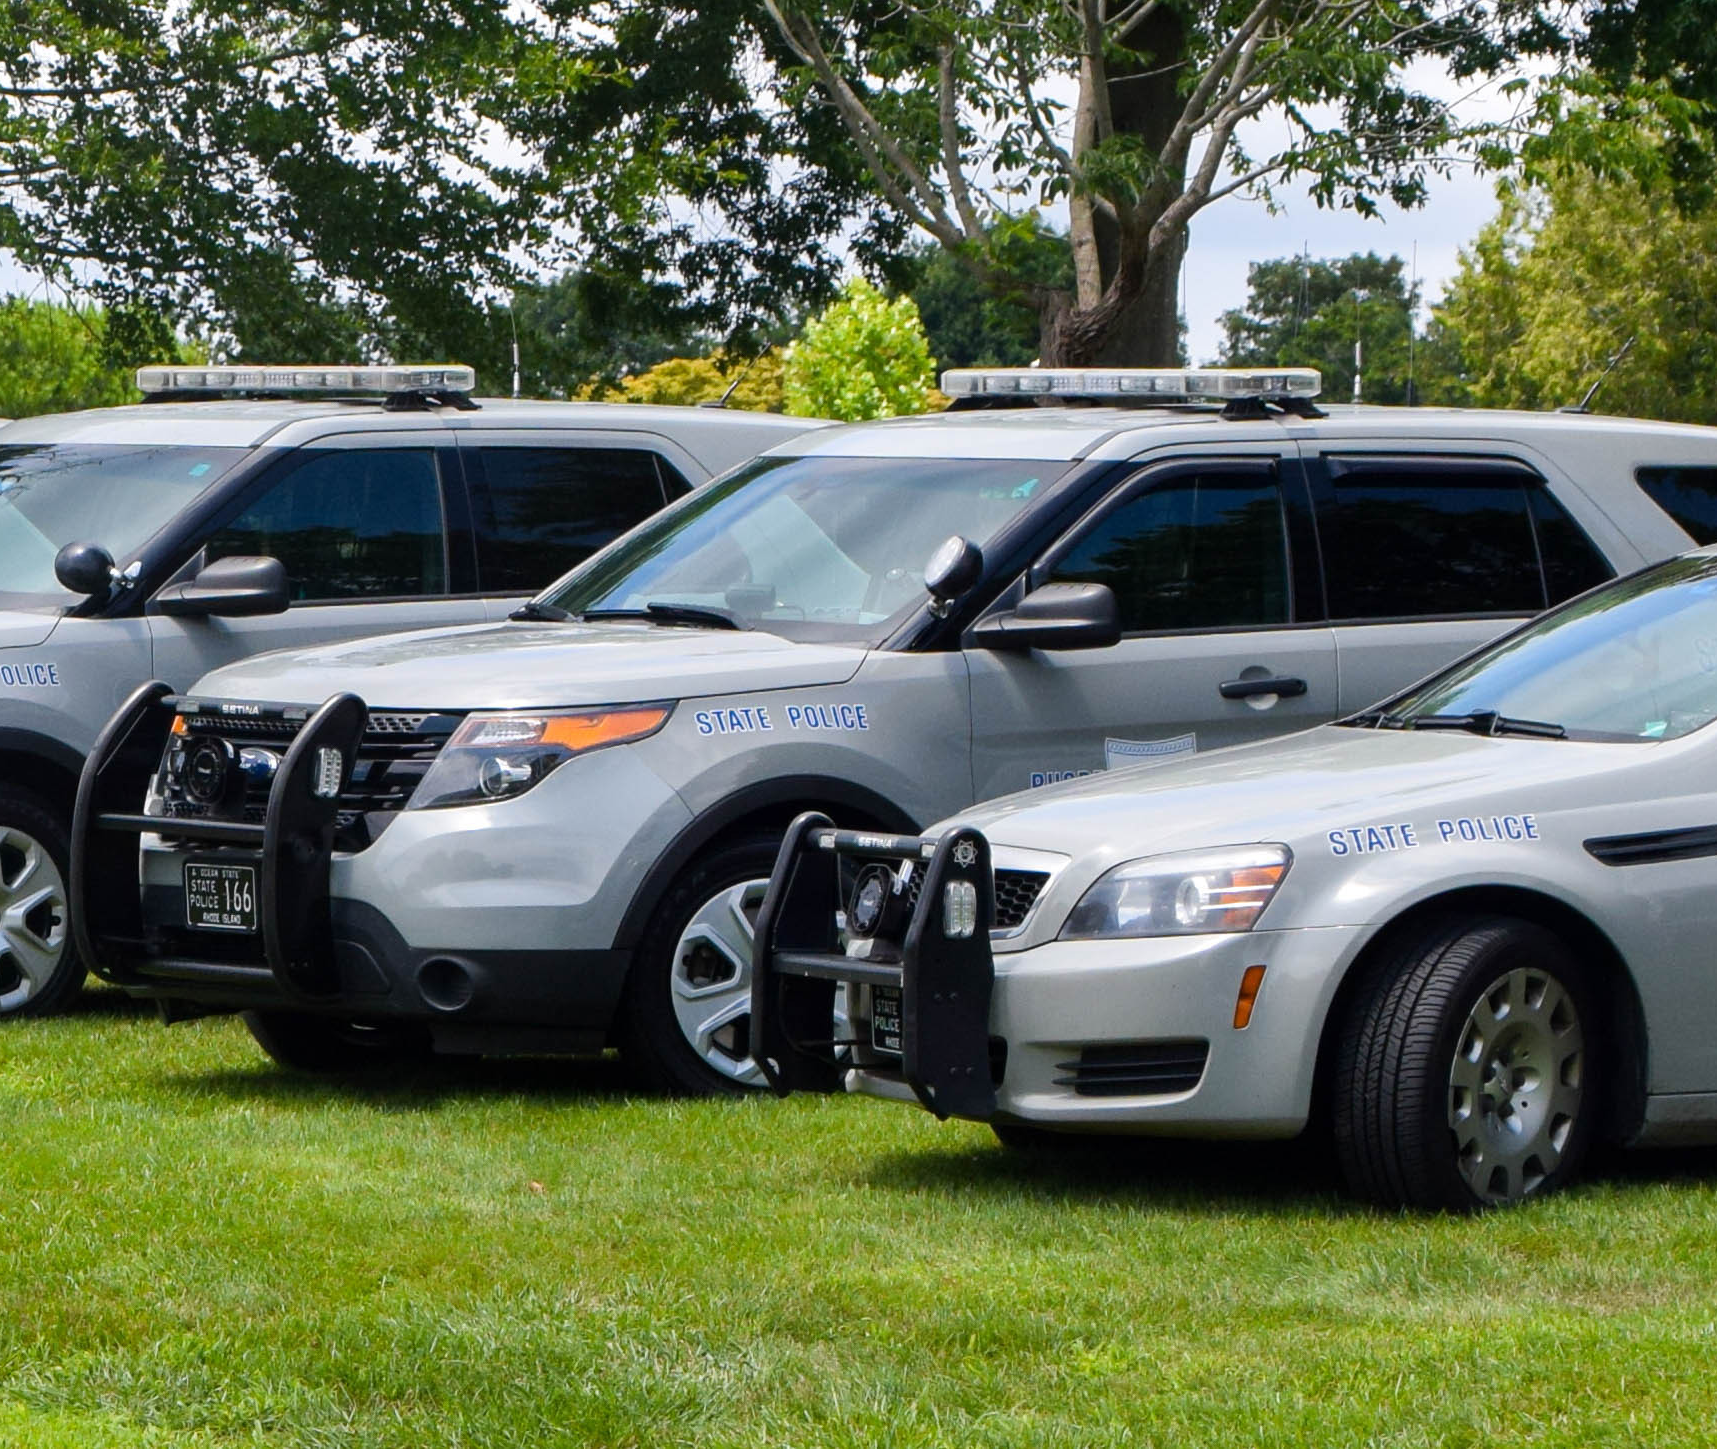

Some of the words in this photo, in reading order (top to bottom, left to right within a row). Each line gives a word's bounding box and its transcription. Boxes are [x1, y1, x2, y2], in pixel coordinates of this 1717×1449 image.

[694, 706, 774, 736] STATE
[785, 703, 870, 730] POLICE
[1328, 822, 1419, 857] STATE
[1435, 813, 1541, 842] POLICE
[191, 879, 217, 893] STATE
[224, 880, 252, 912] 166
[189, 894, 219, 909] POLICE
[875, 1016, 900, 1032] POLICE
